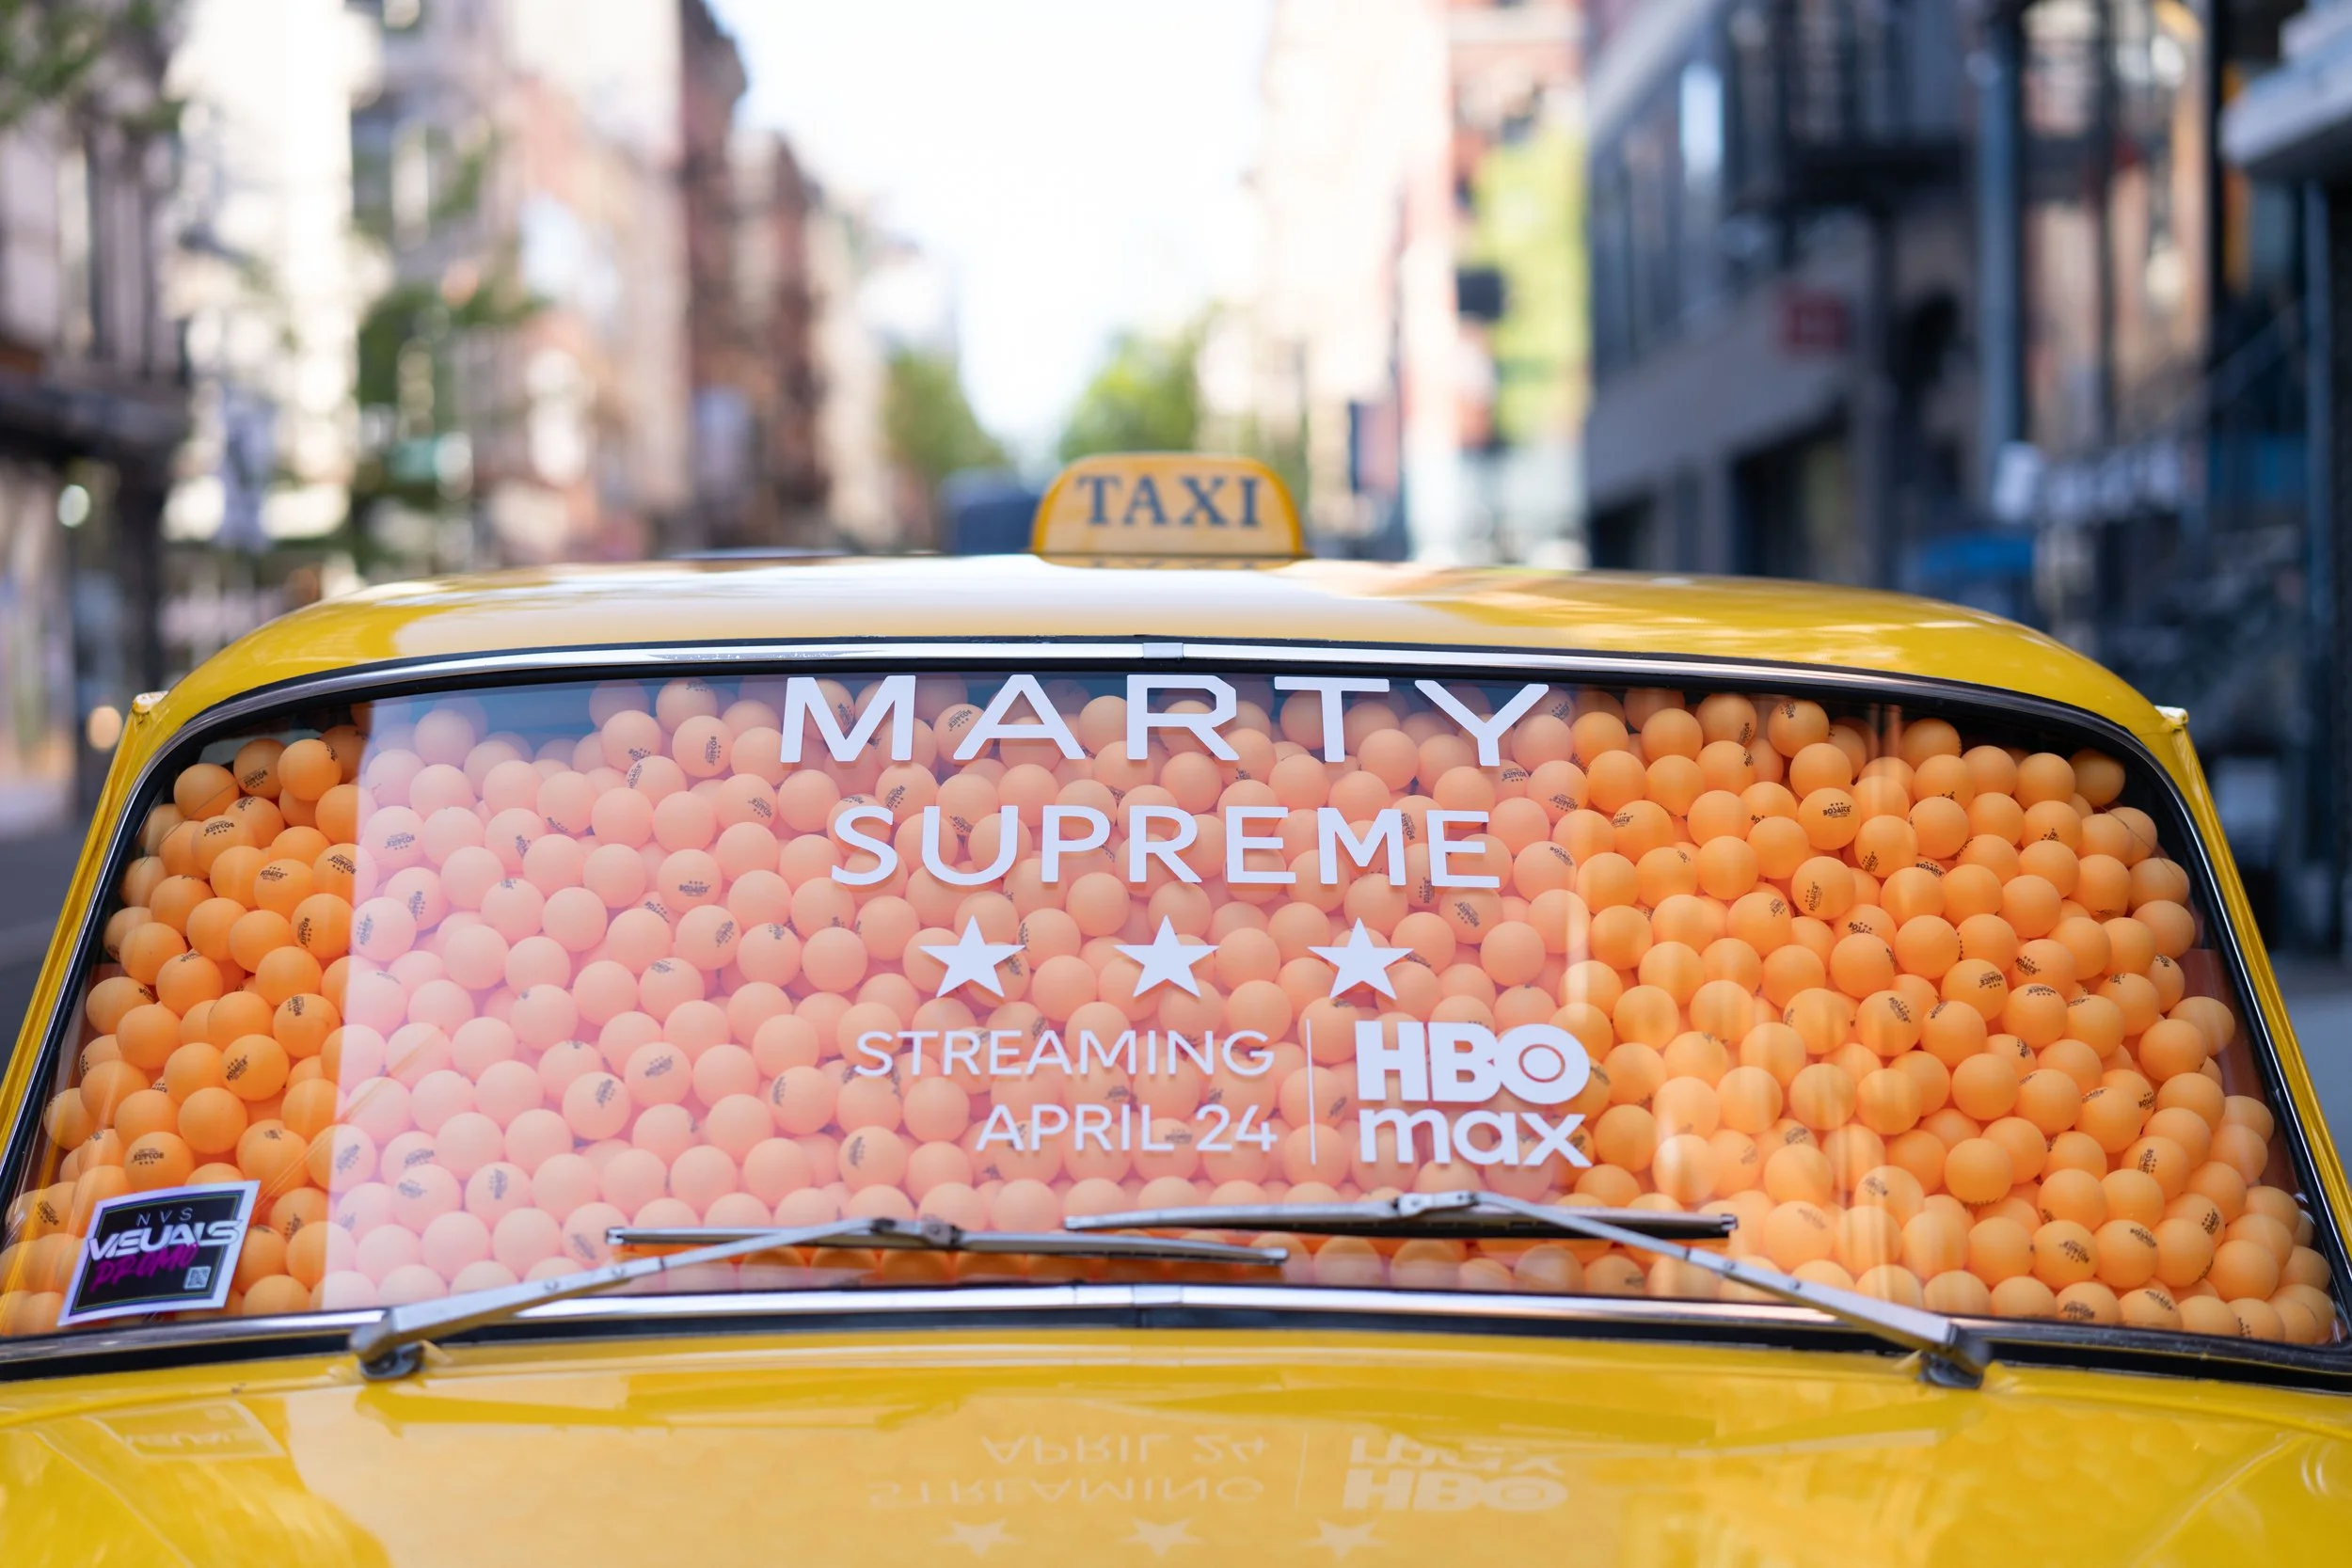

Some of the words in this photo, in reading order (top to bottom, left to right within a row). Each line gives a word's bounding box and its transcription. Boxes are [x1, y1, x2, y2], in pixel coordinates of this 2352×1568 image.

[1075, 474, 1263, 527] TAXI
[780, 674, 1549, 767] MARTY
[831, 805, 1501, 888] SUPREME
[854, 1029, 1275, 1077] STREAMING
[1355, 1020, 1591, 1105] HBO
[976, 1103, 1175, 1153] APRIL
[1196, 1103, 1279, 1153] 24
[1359, 1107, 1593, 1167] max
[88, 1242, 200, 1293] PROMO
